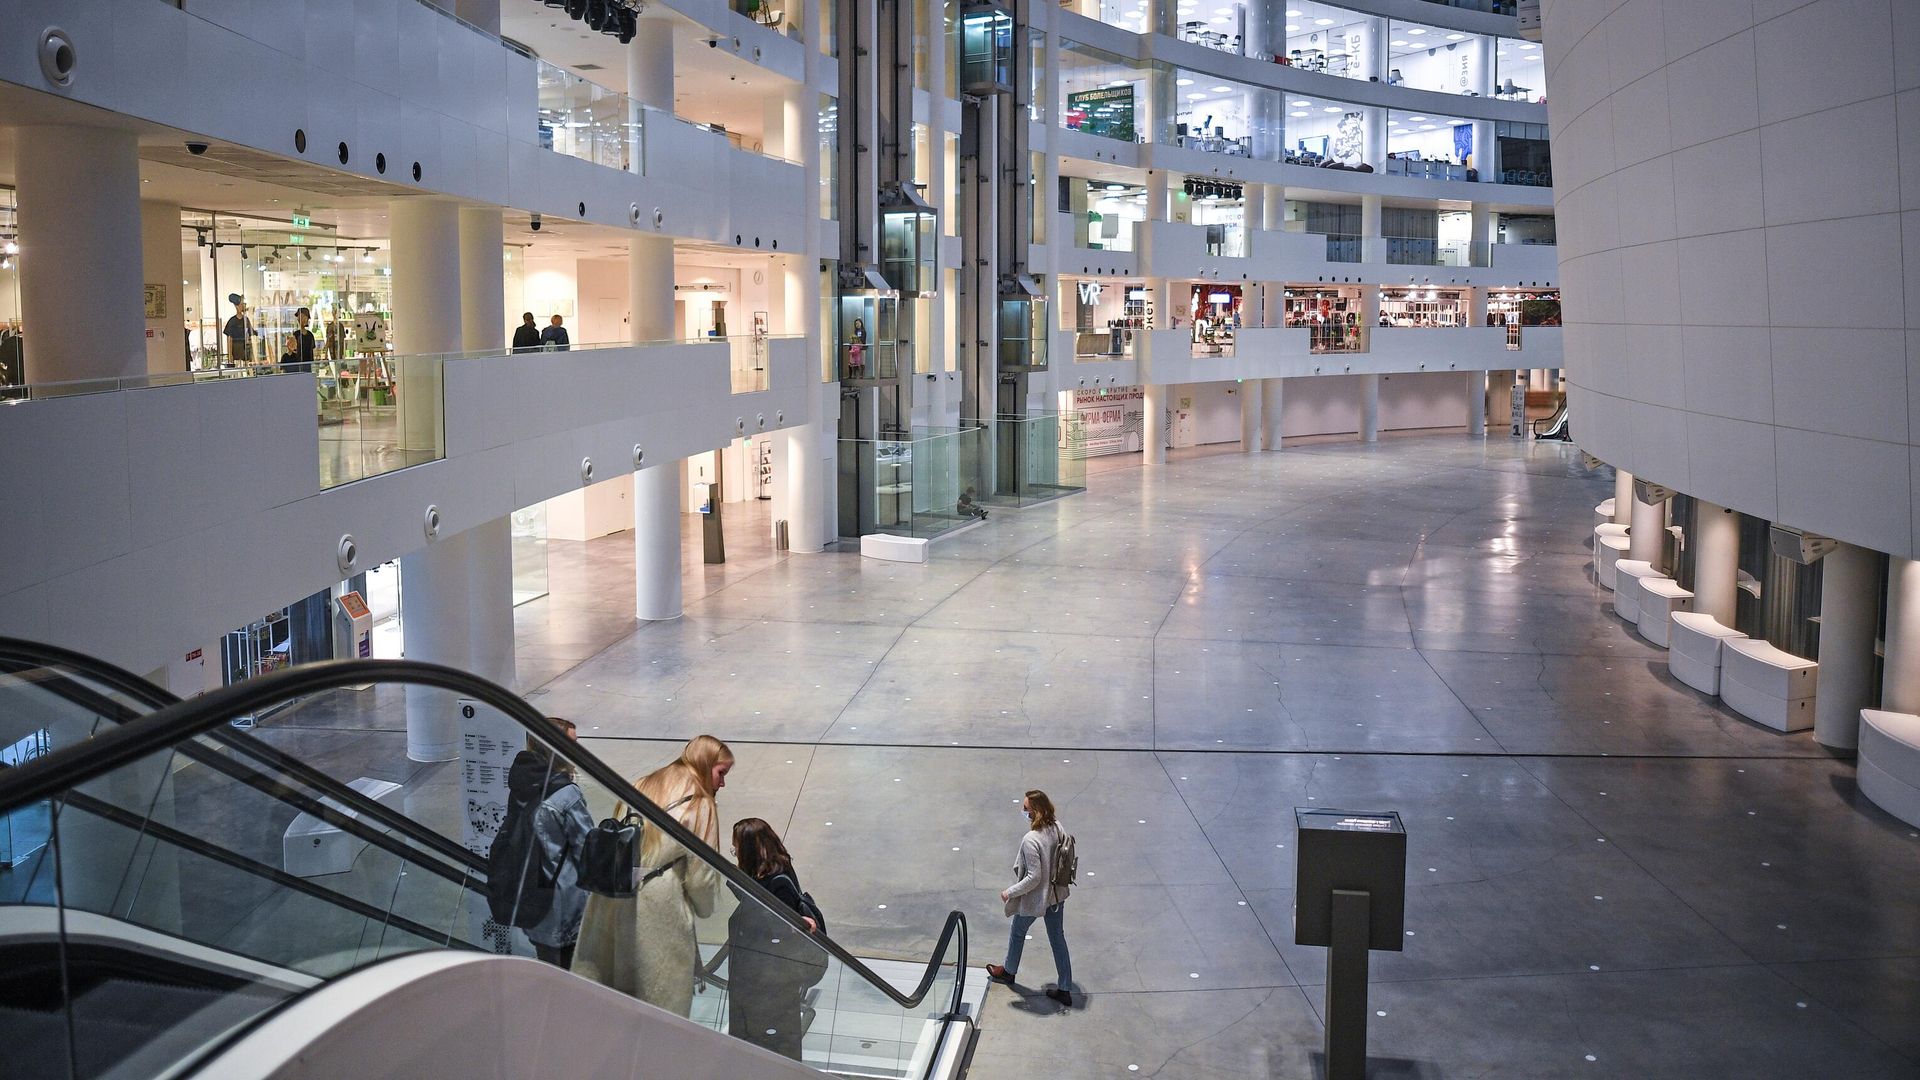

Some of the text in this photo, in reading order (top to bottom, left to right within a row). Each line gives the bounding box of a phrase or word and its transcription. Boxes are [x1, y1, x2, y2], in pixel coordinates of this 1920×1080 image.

[1075, 89, 1132, 103] КЛУБ БОЛЕЛЬЩИКОВ
[1078, 283, 1101, 305] VR
[1077, 388, 1096, 396] СКОРО
[1077, 396, 1095, 404] РЫНОК
[1096, 393, 1128, 403] НАСТОЯЩИХ
[1513, 425, 1521, 436] 1
